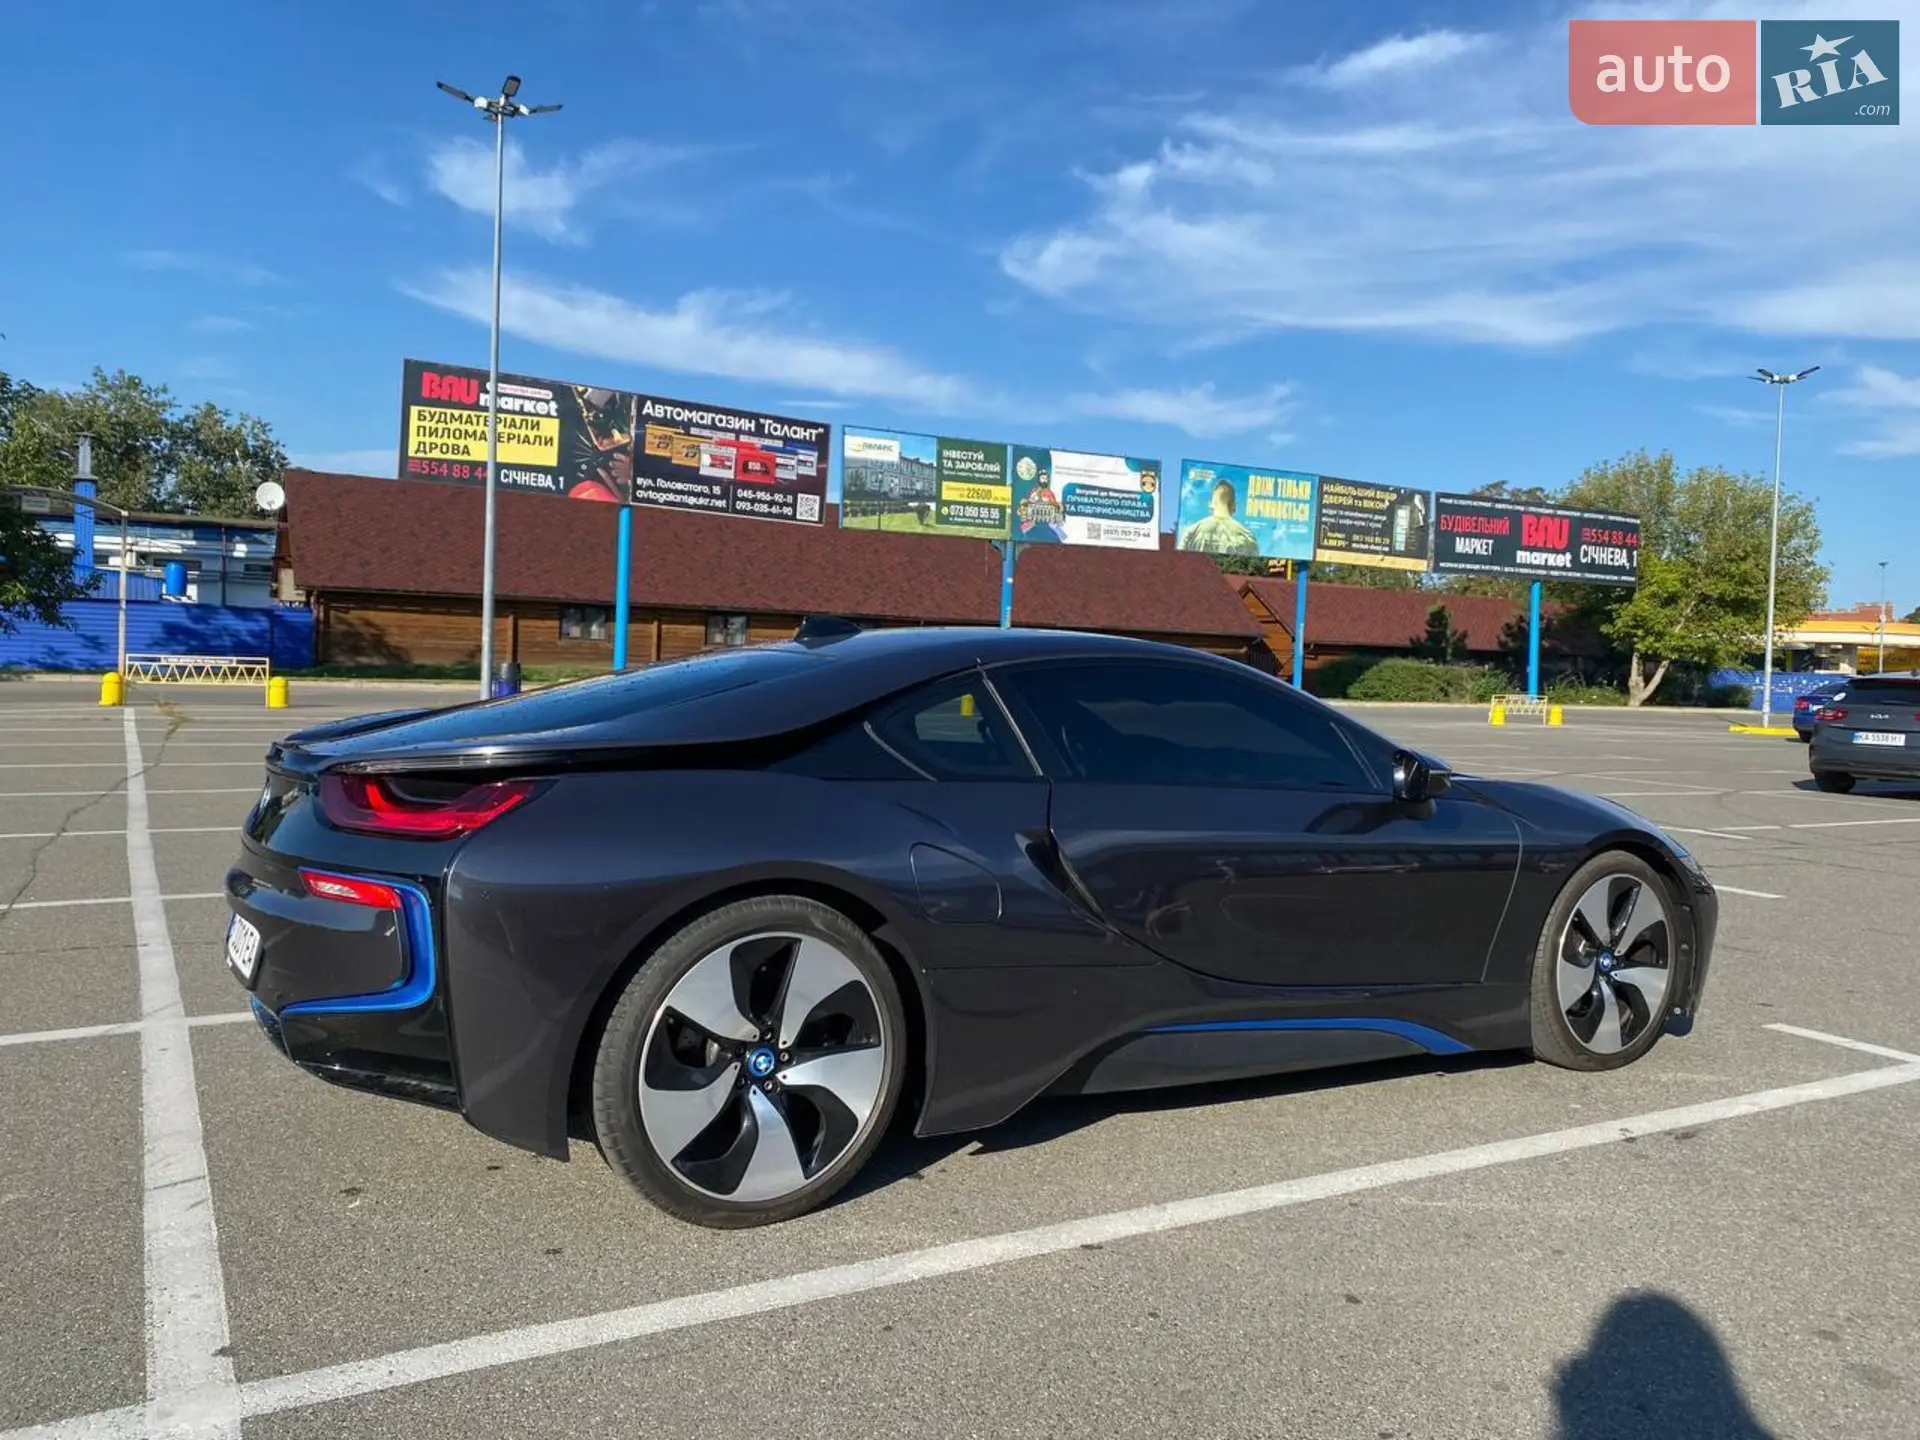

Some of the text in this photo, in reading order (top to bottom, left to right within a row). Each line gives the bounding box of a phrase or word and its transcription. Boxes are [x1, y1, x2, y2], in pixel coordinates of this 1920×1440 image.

[642, 400, 756, 432] Автомагазин
[416, 426, 554, 447] ПИЛОМАЕРІАЛИ
[414, 441, 471, 457] ДРОВА
[942, 449, 984, 461] ІНВЕСТУЙ
[421, 460, 488, 480] 554 88 4
[943, 459, 953, 468] ТА
[500, 468, 565, 490] СІЧНЕВА, 1
[1440, 514, 1509, 535] БУДІВЕЛЬНИЙ
[1455, 537, 1494, 555] МАРКЕТ
[1516, 550, 1572, 568] market
[1580, 544, 1637, 570] СІЧНЕВА, 1
